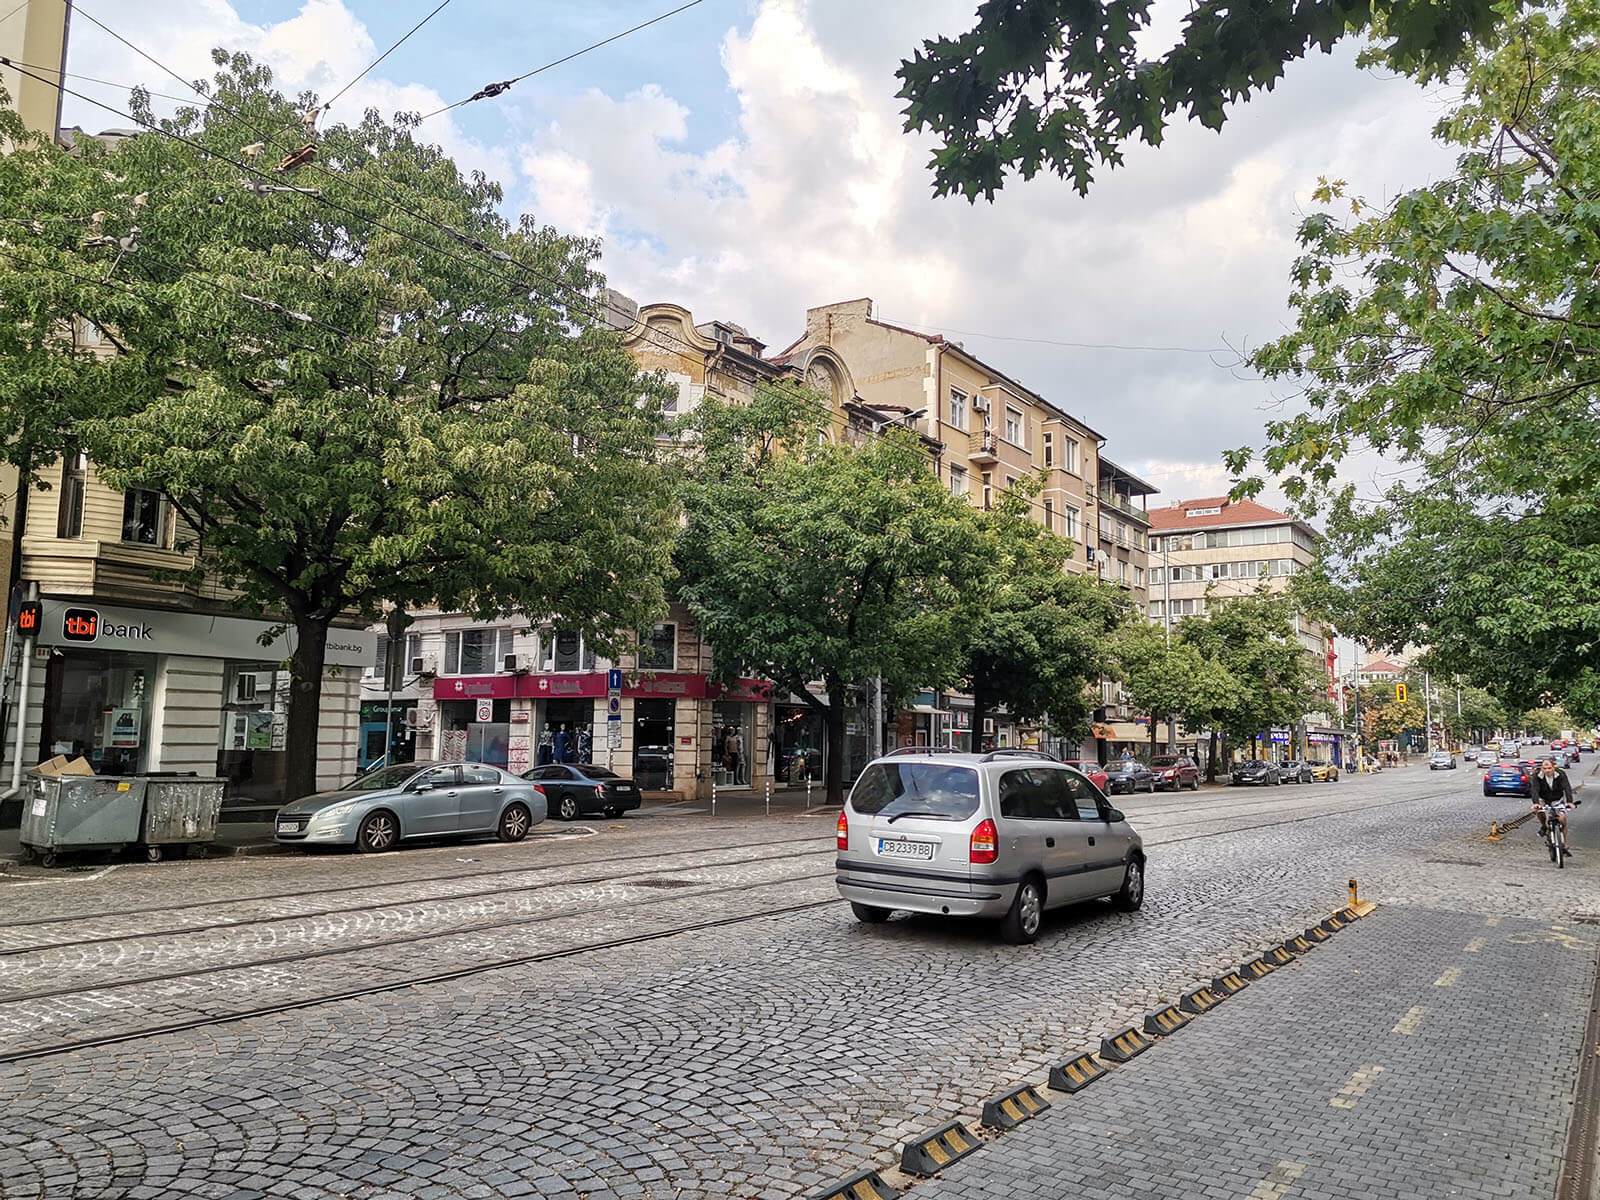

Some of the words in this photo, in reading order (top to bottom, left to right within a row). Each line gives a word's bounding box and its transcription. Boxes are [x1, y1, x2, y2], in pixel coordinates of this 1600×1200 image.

[19, 608, 36, 629] tbi
[65, 616, 97, 636] tbi
[102, 618, 153, 641] bank
[896, 842, 918, 854] 2339
